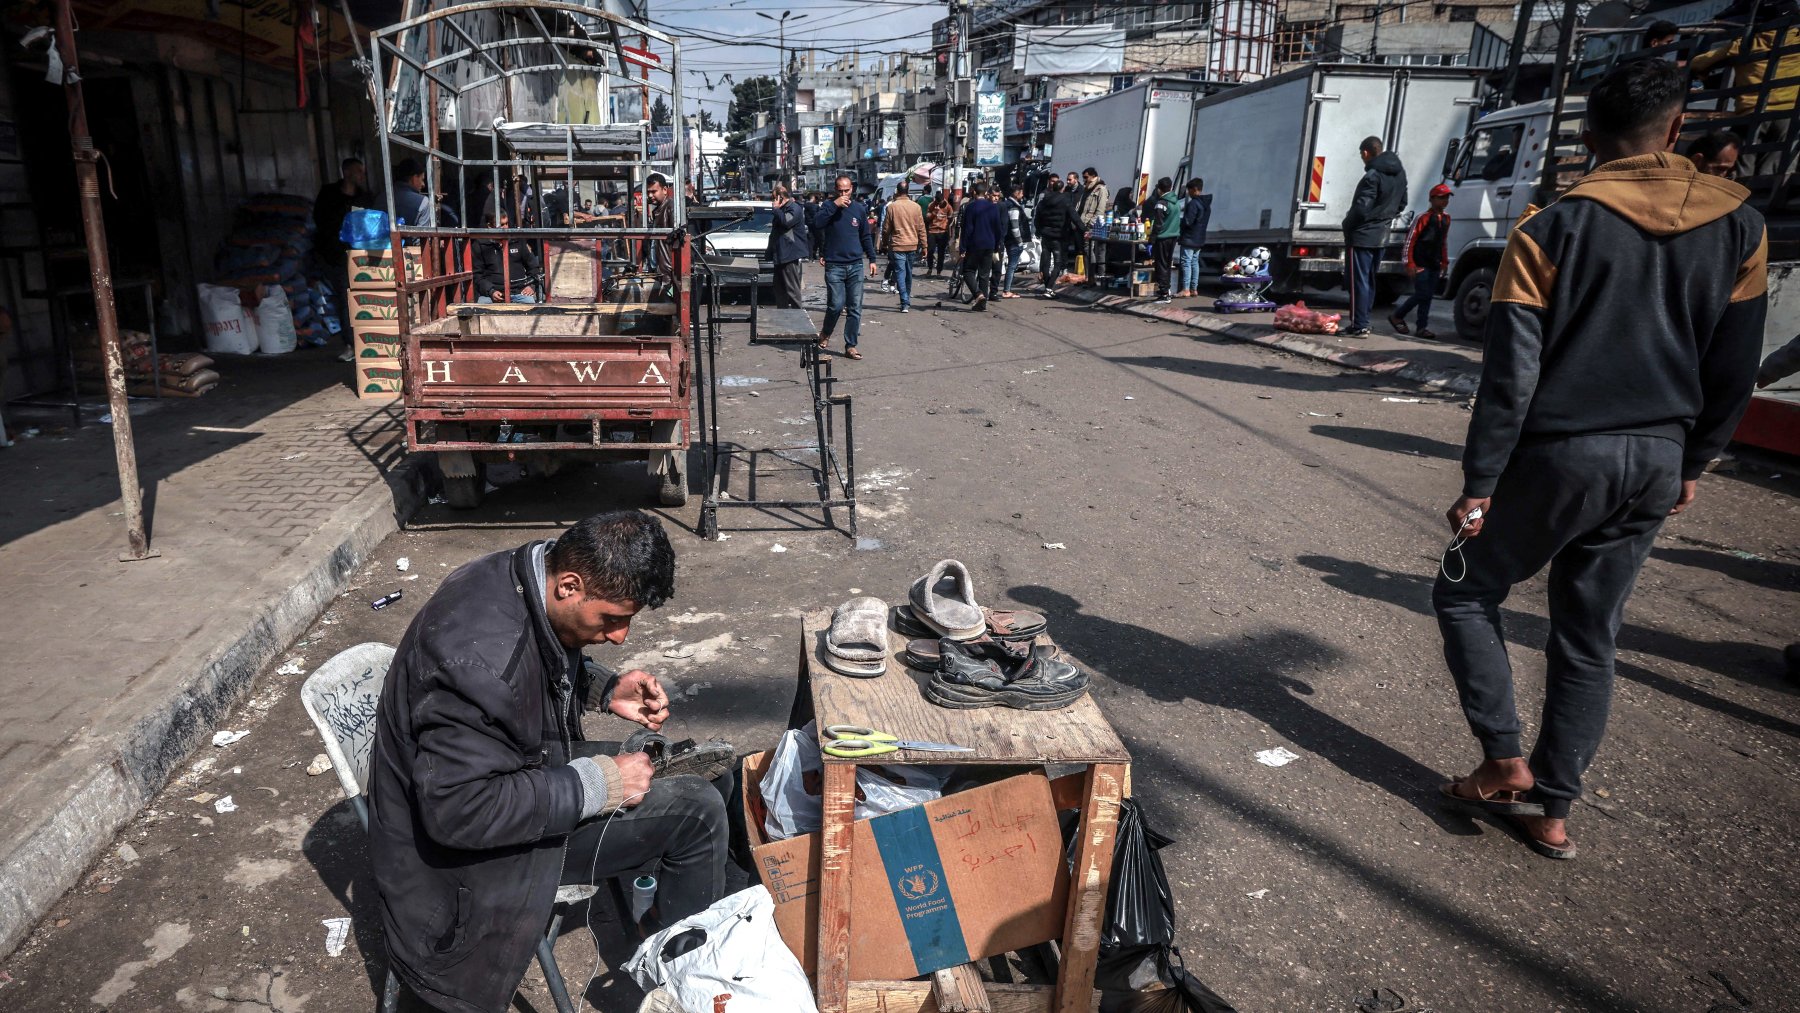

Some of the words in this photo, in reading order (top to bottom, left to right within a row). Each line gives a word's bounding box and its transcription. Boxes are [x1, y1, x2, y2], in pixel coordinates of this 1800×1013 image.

[905, 902, 927, 912] World
[927, 896, 946, 907] Food
[906, 904, 948, 919] Programme
